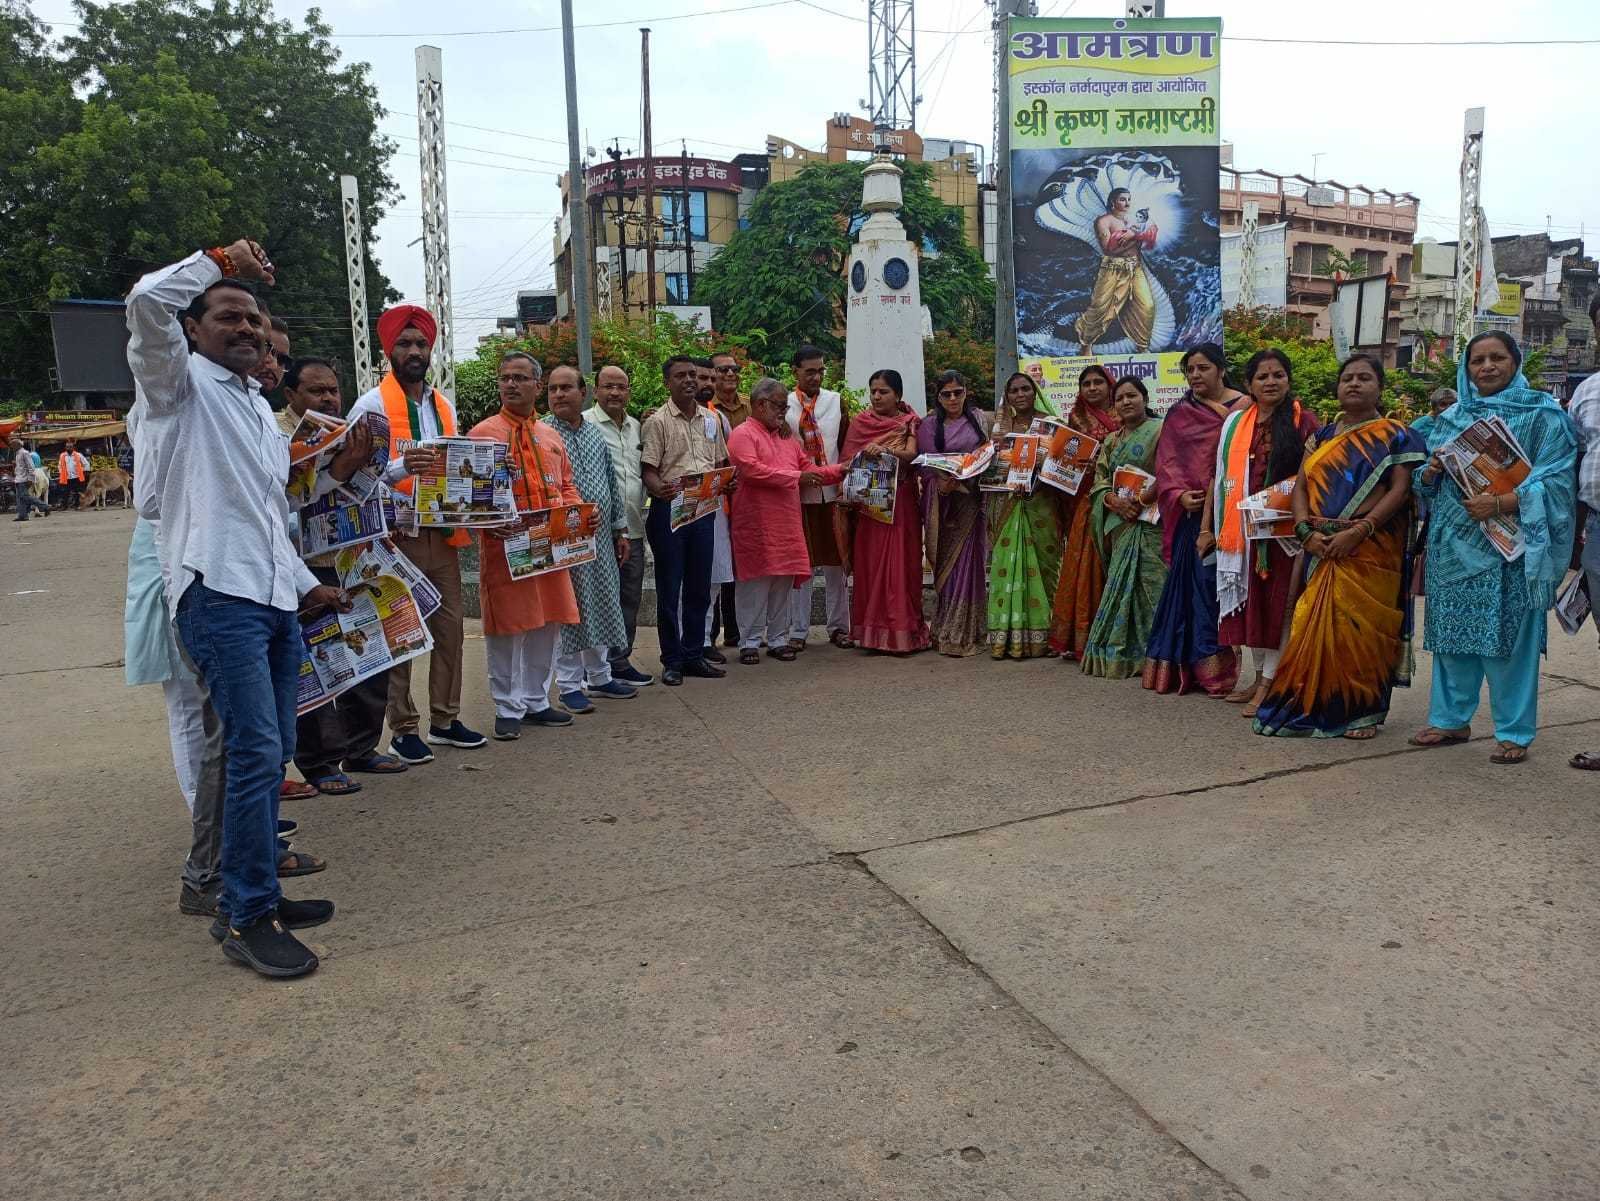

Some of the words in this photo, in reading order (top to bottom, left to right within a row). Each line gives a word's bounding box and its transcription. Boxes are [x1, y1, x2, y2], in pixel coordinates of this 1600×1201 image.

[1011, 20, 1217, 59] आमंत्रण
[1023, 79, 1065, 96] इस्कॉन
[1069, 77, 1128, 97] नर्मदापुरम
[1131, 81, 1153, 95] द्वारा
[1156, 77, 1207, 93] आयोजित
[1013, 98, 1049, 136] श्री
[1054, 109, 1109, 146] कृष्ण
[1114, 96, 1216, 135] जन्माष्टमी
